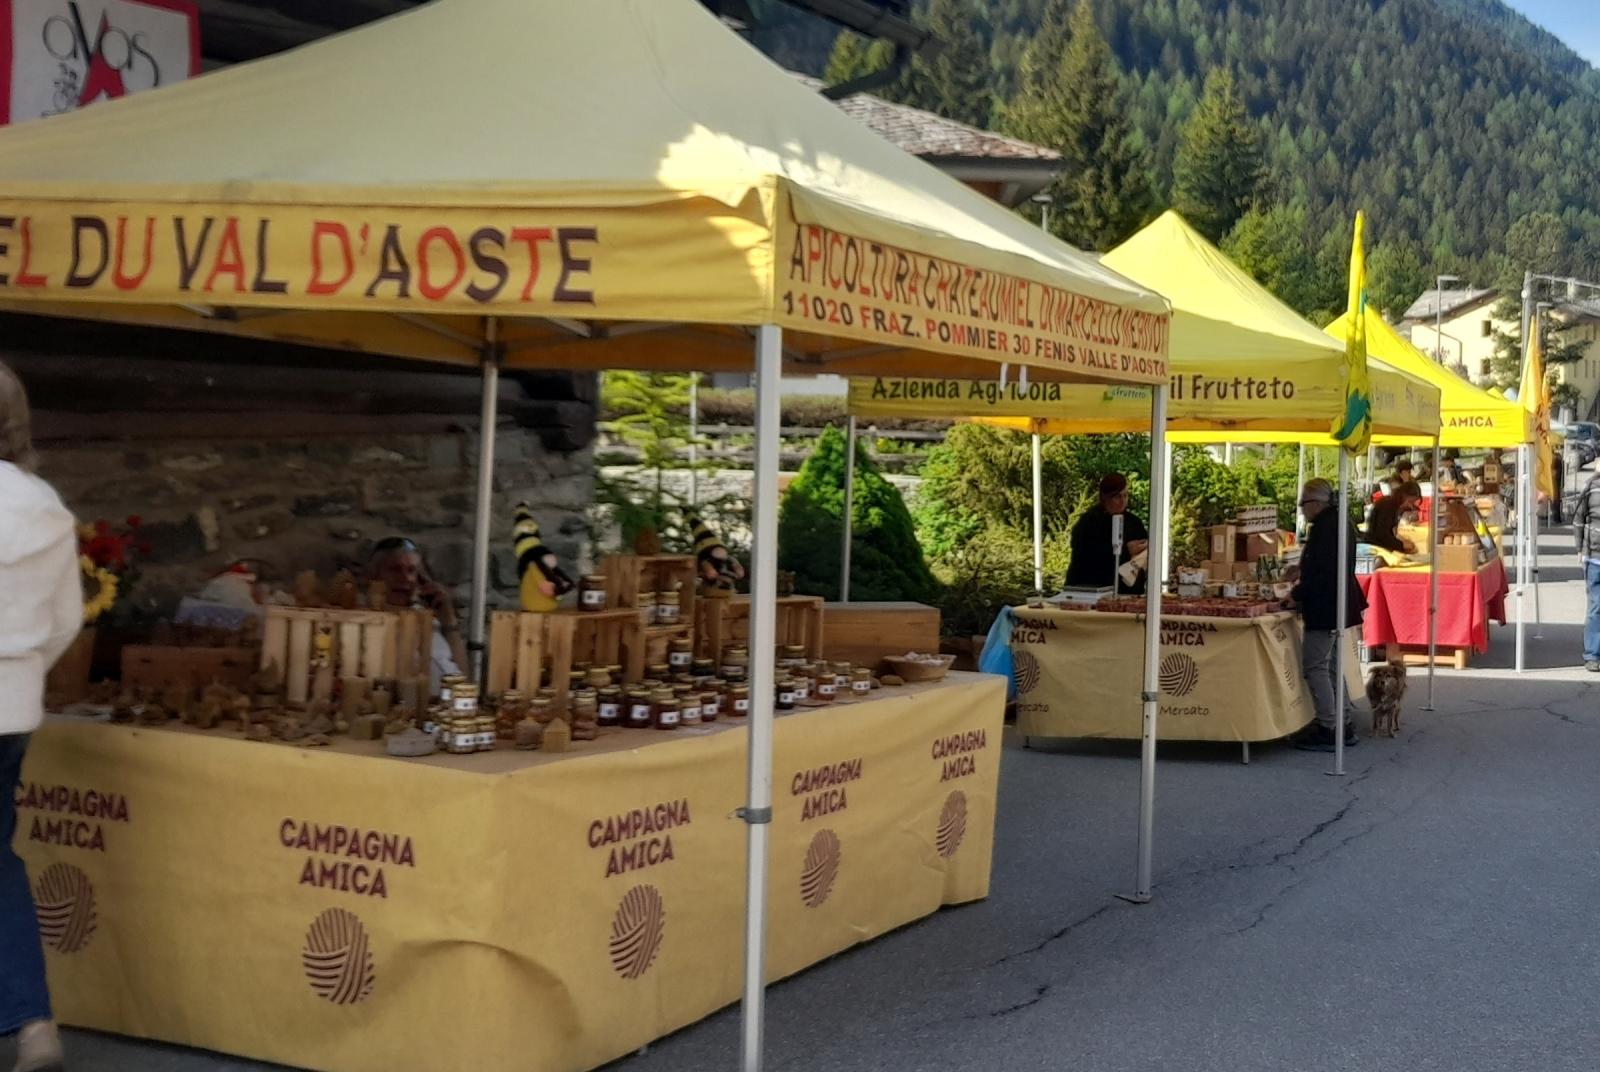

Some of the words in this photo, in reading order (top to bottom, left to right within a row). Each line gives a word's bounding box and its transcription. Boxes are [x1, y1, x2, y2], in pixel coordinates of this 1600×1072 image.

[64, 215, 157, 290] DU
[173, 216, 289, 294] VAL
[305, 221, 599, 304] D'AOSTE
[783, 290, 853, 326] 11020
[860, 304, 920, 338] FRAZ.
[925, 318, 1008, 352] POMMIER
[1013, 333, 1030, 355] 30
[1035, 338, 1075, 363] FENIS
[1079, 350, 1118, 371] VALLE
[1121, 355, 1166, 377] D'AOSTA
[871, 377, 960, 401] Azienda
[1170, 374, 1183, 399] il
[1191, 374, 1294, 399] Frutteto
[1449, 415, 1493, 428] AMICA
[1011, 631, 1046, 643] MICA
[1159, 705, 1209, 716] Mercato
[931, 728, 986, 760] CAMPAGNA
[791, 758, 863, 796] CAMPAGNA
[940, 755, 975, 783] AMICA
[801, 789, 847, 822] AMICA
[29, 816, 105, 852] AMICA
[588, 798, 690, 849] CAMPAGNA
[280, 817, 415, 867] CAMPAGNA
[605, 835, 674, 878] AMICA
[299, 860, 388, 898] AMICA
